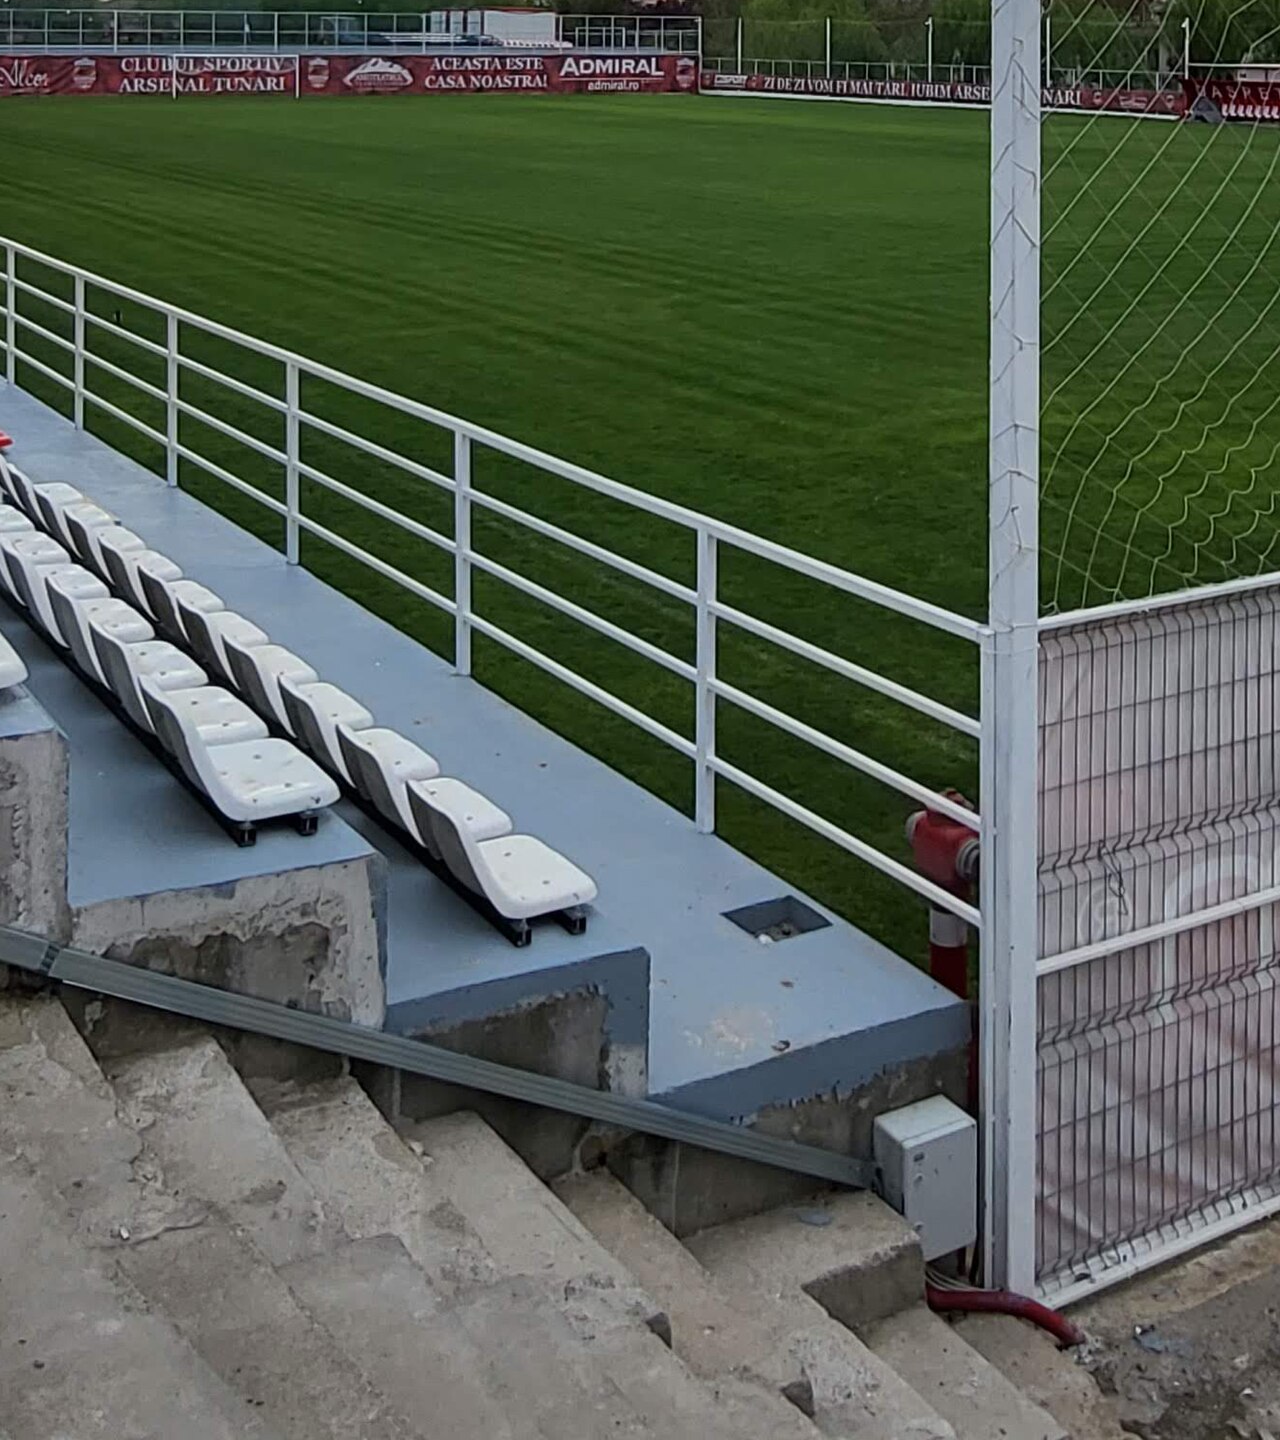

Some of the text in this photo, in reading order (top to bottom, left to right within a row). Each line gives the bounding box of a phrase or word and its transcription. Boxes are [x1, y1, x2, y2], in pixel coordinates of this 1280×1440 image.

[121, 57, 285, 73] CLUBUL SPORTIV
[430, 57, 543, 71] ACEASTA ESTE
[560, 57, 665, 77] ADMIRAL
[119, 76, 286, 93] ARSENAL TUNARI
[425, 74, 548, 89] CASA NOASTRA!
[587, 79, 640, 91] admiral.ro
[763, 77, 775, 89] ZI
[777, 78, 792, 91] DE
[793, 78, 805, 92] ZI
[806, 79, 833, 93] VOM
[836, 80, 847, 94] FI
[848, 80, 871, 95] MAI
[911, 82, 952, 98] IUBIM
[953, 85, 991, 101] ARSE
[1041, 88, 1081, 106] NARI
